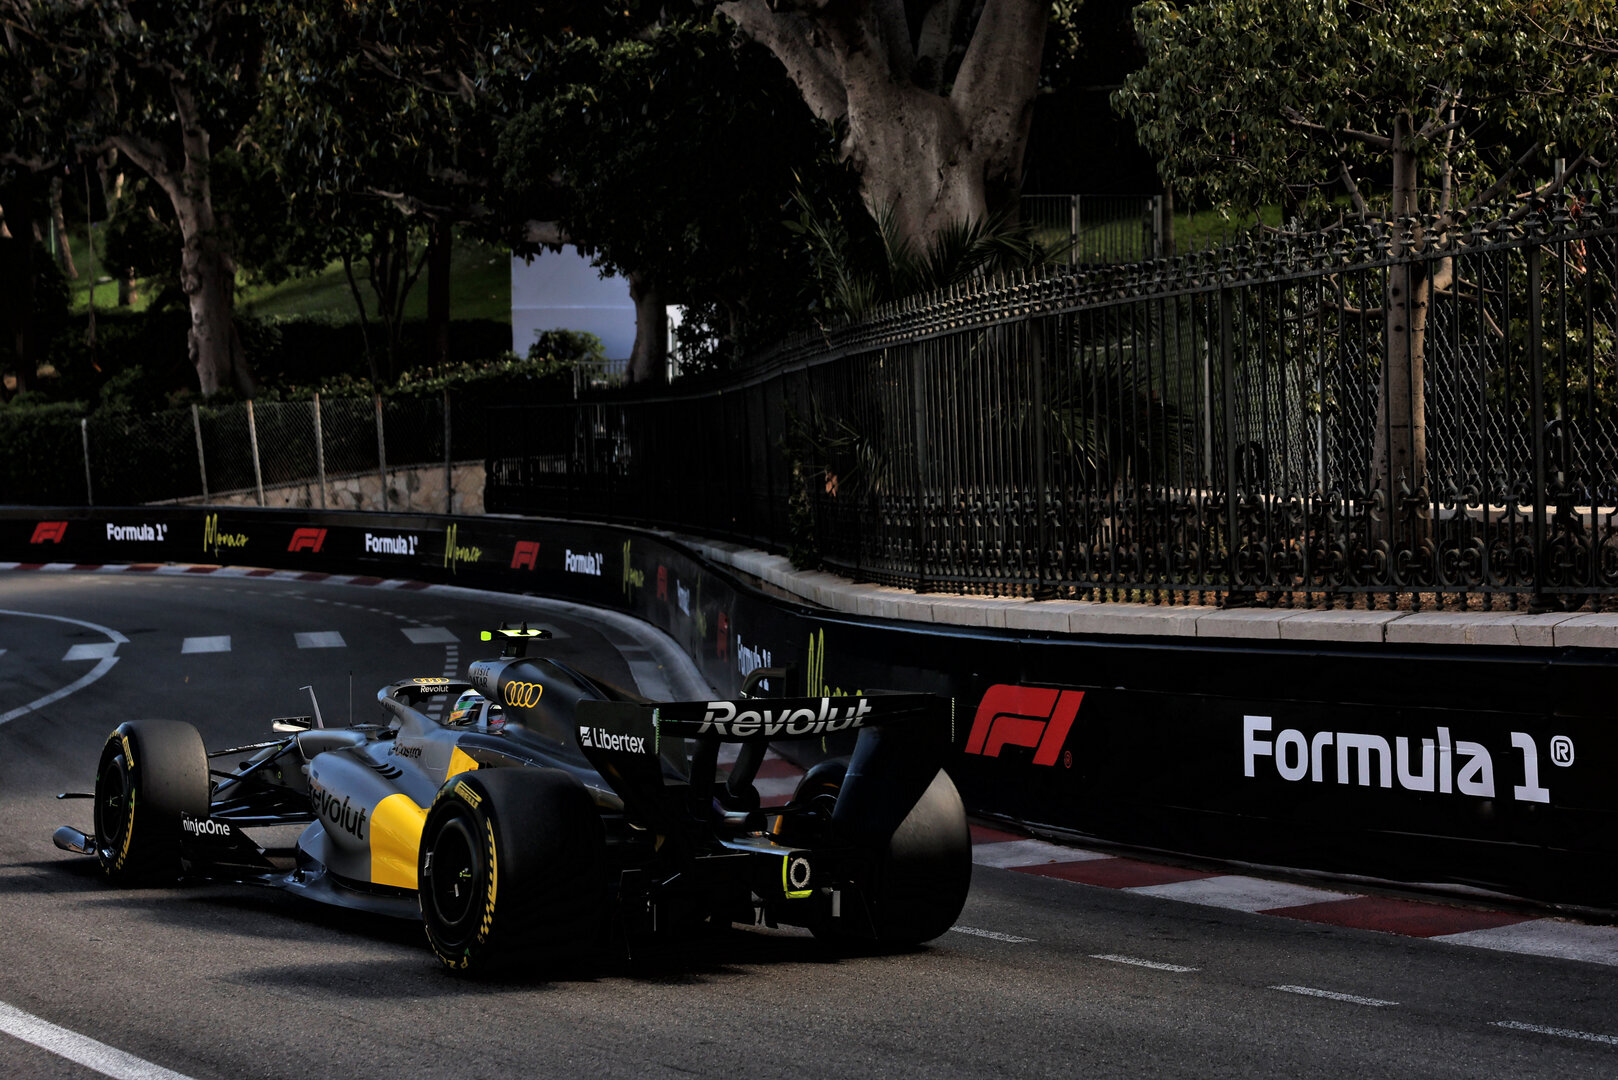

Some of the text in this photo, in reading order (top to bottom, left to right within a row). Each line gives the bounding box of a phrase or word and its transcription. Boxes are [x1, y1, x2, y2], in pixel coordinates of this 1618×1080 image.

[106, 523, 155, 541] Formula
[365, 533, 408, 555] Formula
[565, 548, 596, 575] Formula
[420, 685, 449, 693] Revolut
[698, 697, 872, 736] Revolut
[593, 727, 646, 754] Libertex
[1243, 715, 1496, 798] Formula
[183, 816, 231, 836] ninjaOne
